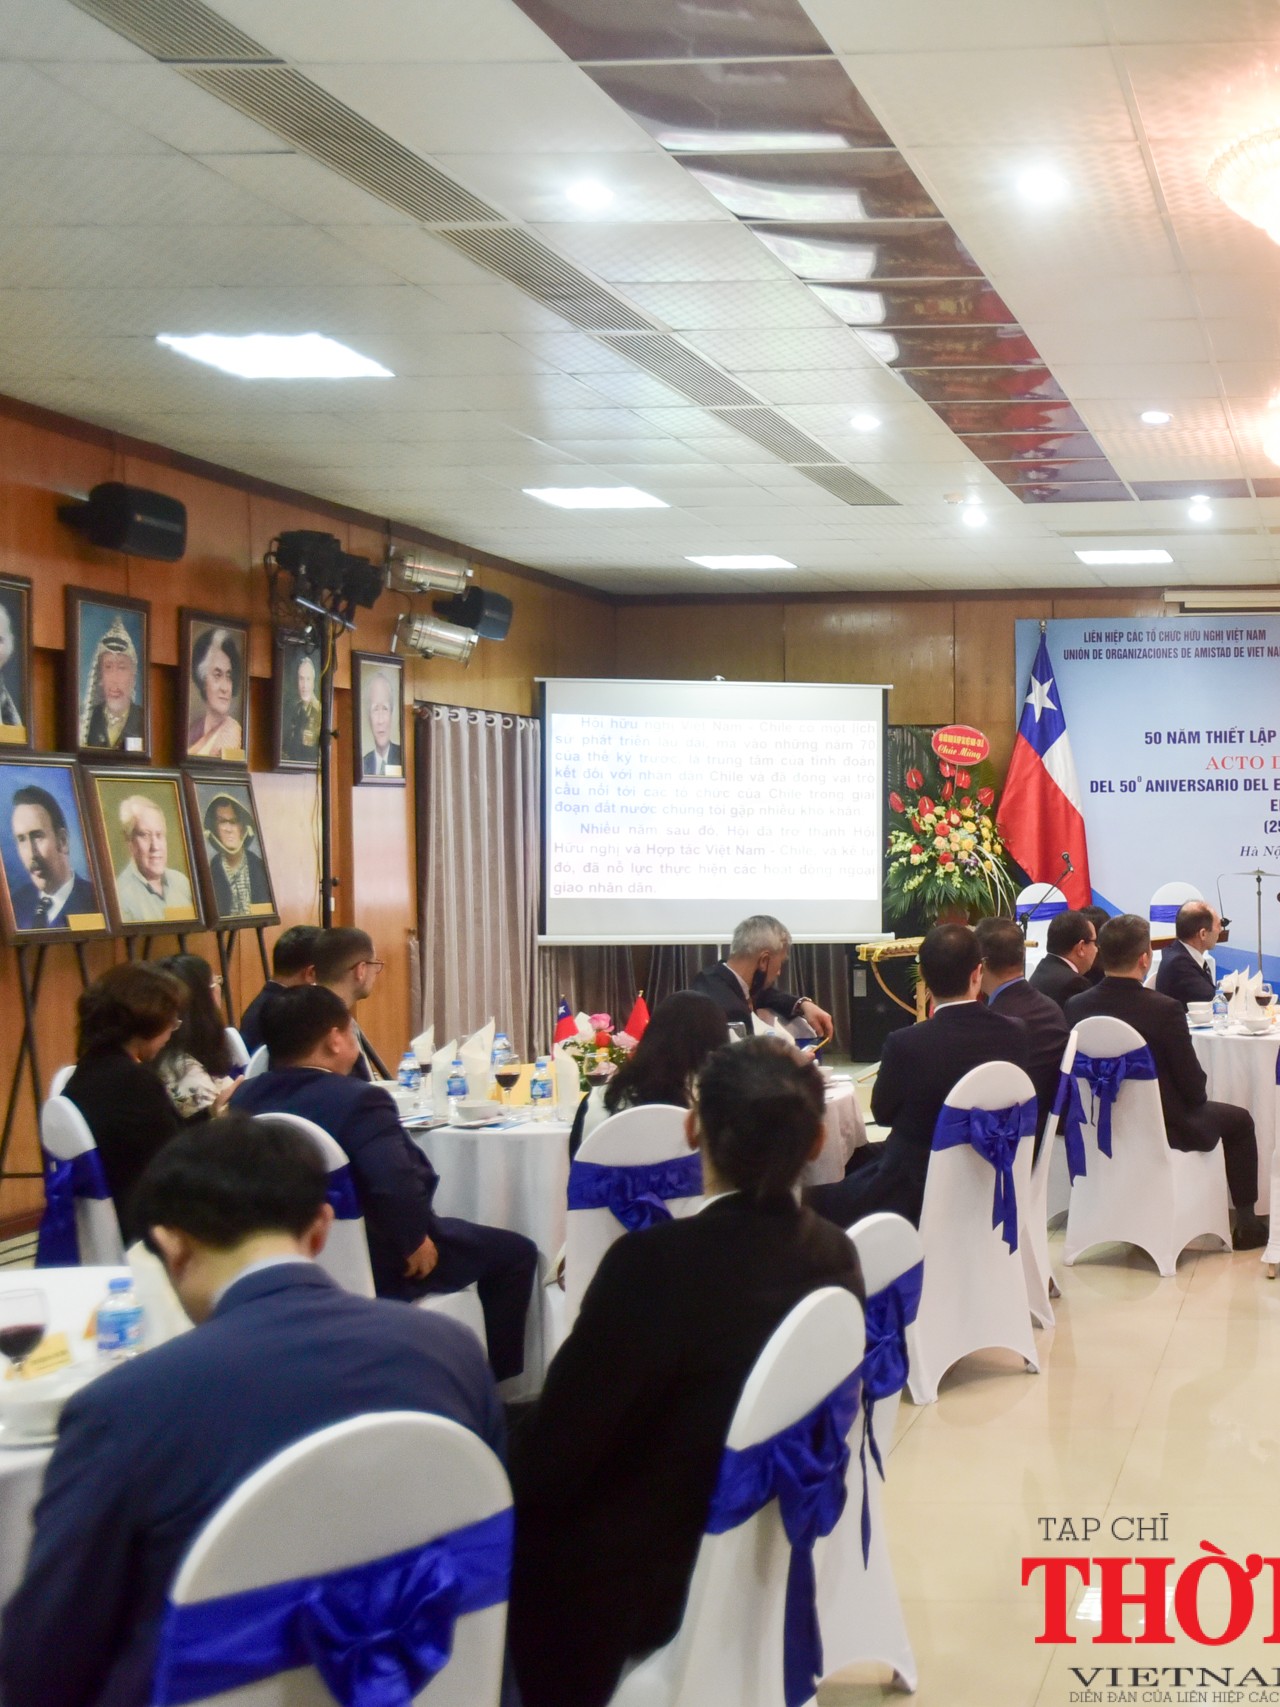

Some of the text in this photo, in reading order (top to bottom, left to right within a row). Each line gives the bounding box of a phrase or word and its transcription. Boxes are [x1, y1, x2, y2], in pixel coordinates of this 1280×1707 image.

[1084, 630, 1102, 643] LIÊN
[1105, 630, 1123, 645] HIỆP
[1127, 629, 1143, 642] CÁC
[1203, 630, 1224, 643] NGHỊ
[1226, 628, 1244, 643] VIỆT
[1246, 630, 1266, 641] NAM
[1064, 647, 1090, 660] UNIÓN
[1093, 649, 1103, 660] DE
[1106, 648, 1178, 659] ORGANIZACIONES
[1181, 648, 1192, 658] DE
[1195, 647, 1231, 658] AMISTAD
[1234, 647, 1244, 658] DE
[1247, 646, 1264, 657] VIET
[1144, 731, 1162, 745] 50
[1167, 728, 1200, 744] NĂM
[1206, 725, 1245, 744] THIẾT
[1250, 727, 1276, 746] LẬP
[1205, 755, 1265, 770] ACTO
[1090, 780, 1115, 793] DEL
[1145, 778, 1239, 792] ANIVERSARIO
[1243, 779, 1269, 791] DEL
[1240, 845, 1259, 857] Hà
